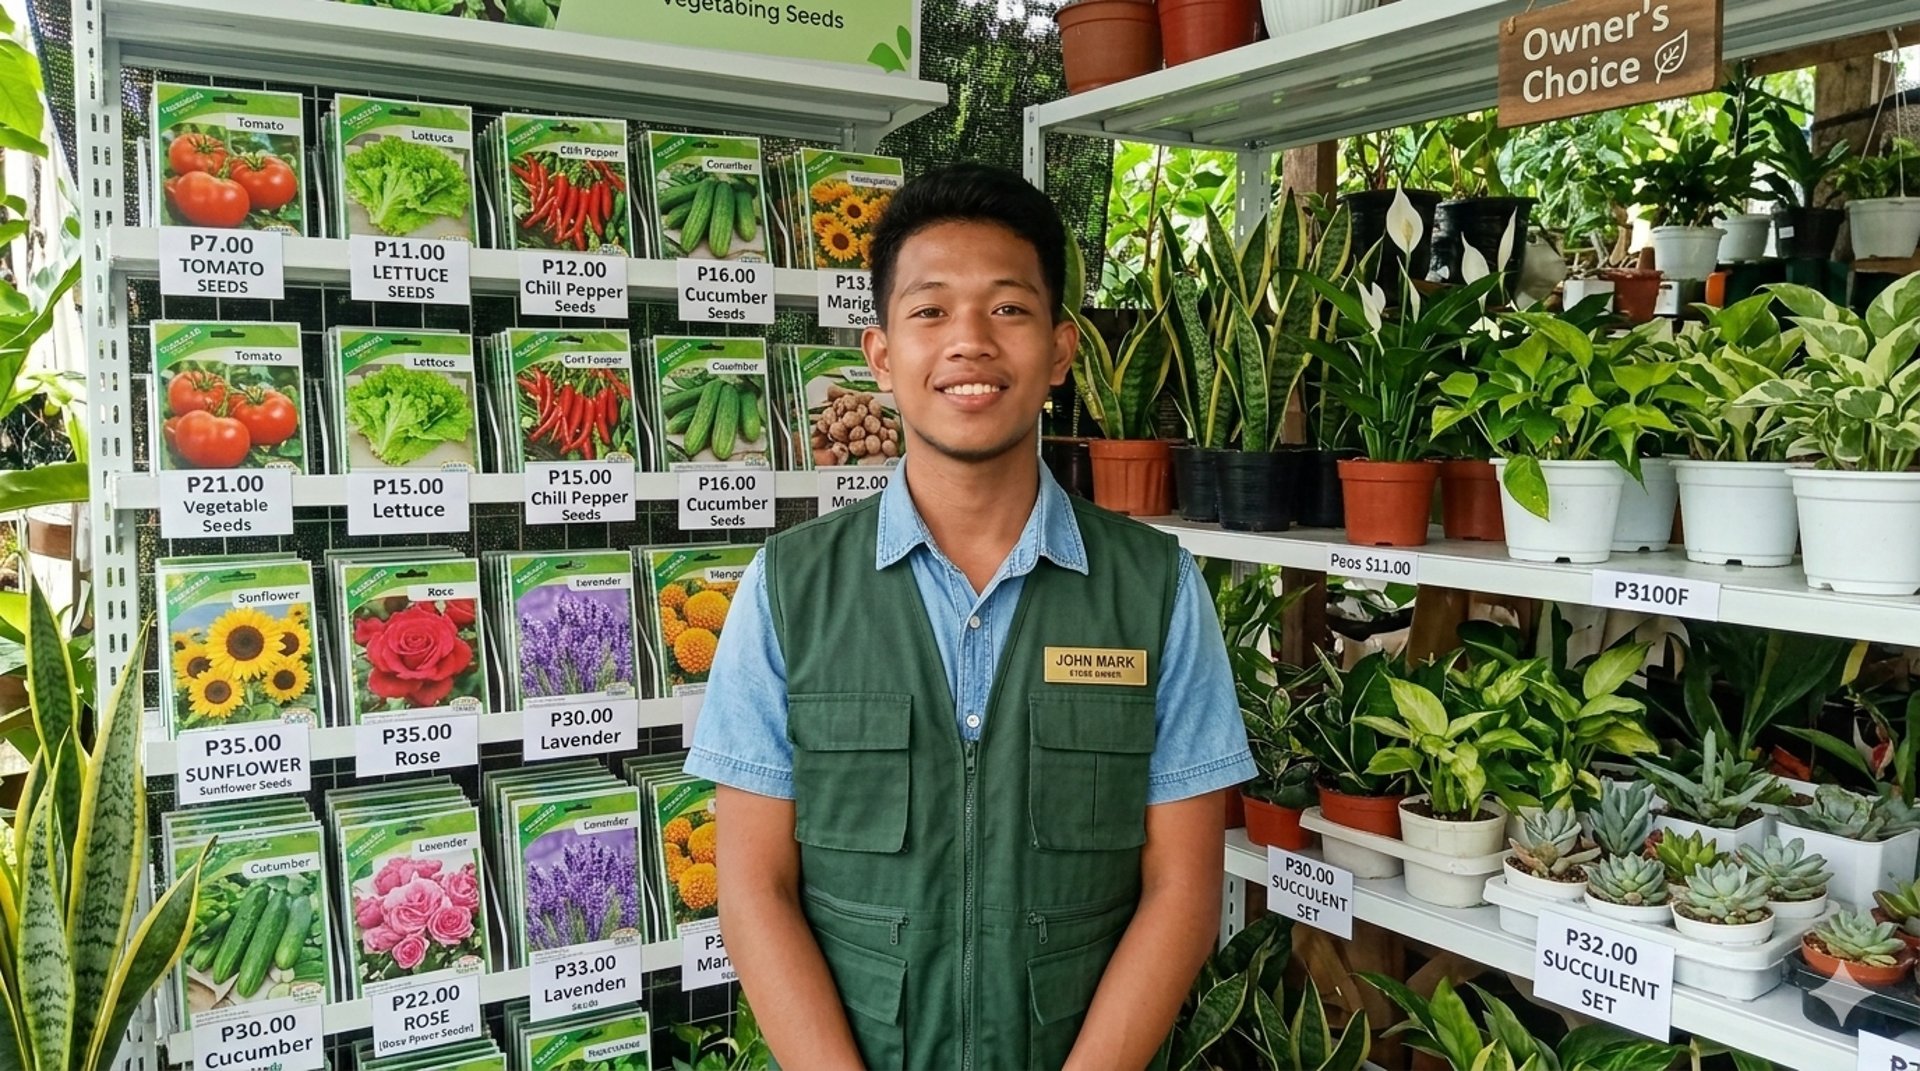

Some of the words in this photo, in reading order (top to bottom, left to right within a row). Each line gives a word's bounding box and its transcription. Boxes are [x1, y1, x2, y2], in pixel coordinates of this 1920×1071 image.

[664, 0, 780, 25] egetabing
[786, 4, 844, 29] Seeds
[1523, 0, 1670, 61] Owner's
[1523, 56, 1640, 103] Choice
[237, 116, 284, 131] Tomato
[190, 235, 254, 254] P7.00
[374, 241, 445, 261] P11.00
[179, 257, 264, 276] TOMATO
[373, 264, 449, 283] LETTUCE
[542, 259, 607, 278] P12.00
[698, 266, 756, 284] P16.00
[198, 279, 248, 294] SEEDS
[388, 285, 435, 300] SEEDS
[525, 280, 561, 296] Chill
[566, 282, 623, 299] Pepper
[836, 275, 873, 291] P13.
[685, 287, 768, 305] Cucumber
[555, 300, 596, 314] Seeds
[235, 351, 282, 362] Tomato
[187, 475, 264, 493] P21.00
[373, 478, 444, 496] P15.00
[549, 469, 612, 486] P15.00
[699, 476, 756, 491] P16.00
[837, 476, 888, 490] P12.00
[183, 499, 268, 515] Vegetable
[531, 492, 568, 506] Chill
[572, 490, 629, 508] Pepper
[687, 496, 768, 512] Cucumber
[373, 502, 445, 519] Lettuce
[562, 508, 601, 521] Seeds
[203, 519, 251, 532] Seeds
[710, 514, 746, 527] Seeds
[1331, 553, 1361, 570] Peos
[1365, 556, 1411, 575] $11.00
[238, 590, 300, 603] Sunflower
[1615, 582, 1689, 606] P3100F
[1056, 654, 1092, 667] JOHN
[1096, 655, 1135, 668] MARK
[551, 708, 612, 727] P30.00
[383, 724, 452, 744] P35.00
[541, 731, 621, 750] Lavender
[205, 734, 281, 756] P35.00
[395, 750, 441, 765] Rose
[186, 757, 302, 782] SUNFLOWER
[259, 778, 292, 790] Seeds
[1286, 857, 1335, 886] P30.00
[1272, 874, 1348, 912] SUCCULENT
[1297, 903, 1320, 922] SET
[705, 934, 724, 950] P3
[1567, 928, 1638, 965] P32.00
[555, 955, 616, 979] P33.00
[1543, 949, 1660, 1001] SUCCULENT
[392, 985, 460, 1011] P22.00
[544, 977, 626, 1003] Lavenden
[1581, 989, 1617, 1014] SET
[221, 1015, 296, 1042] P30.00
[205, 1037, 313, 1069] Cucumber
